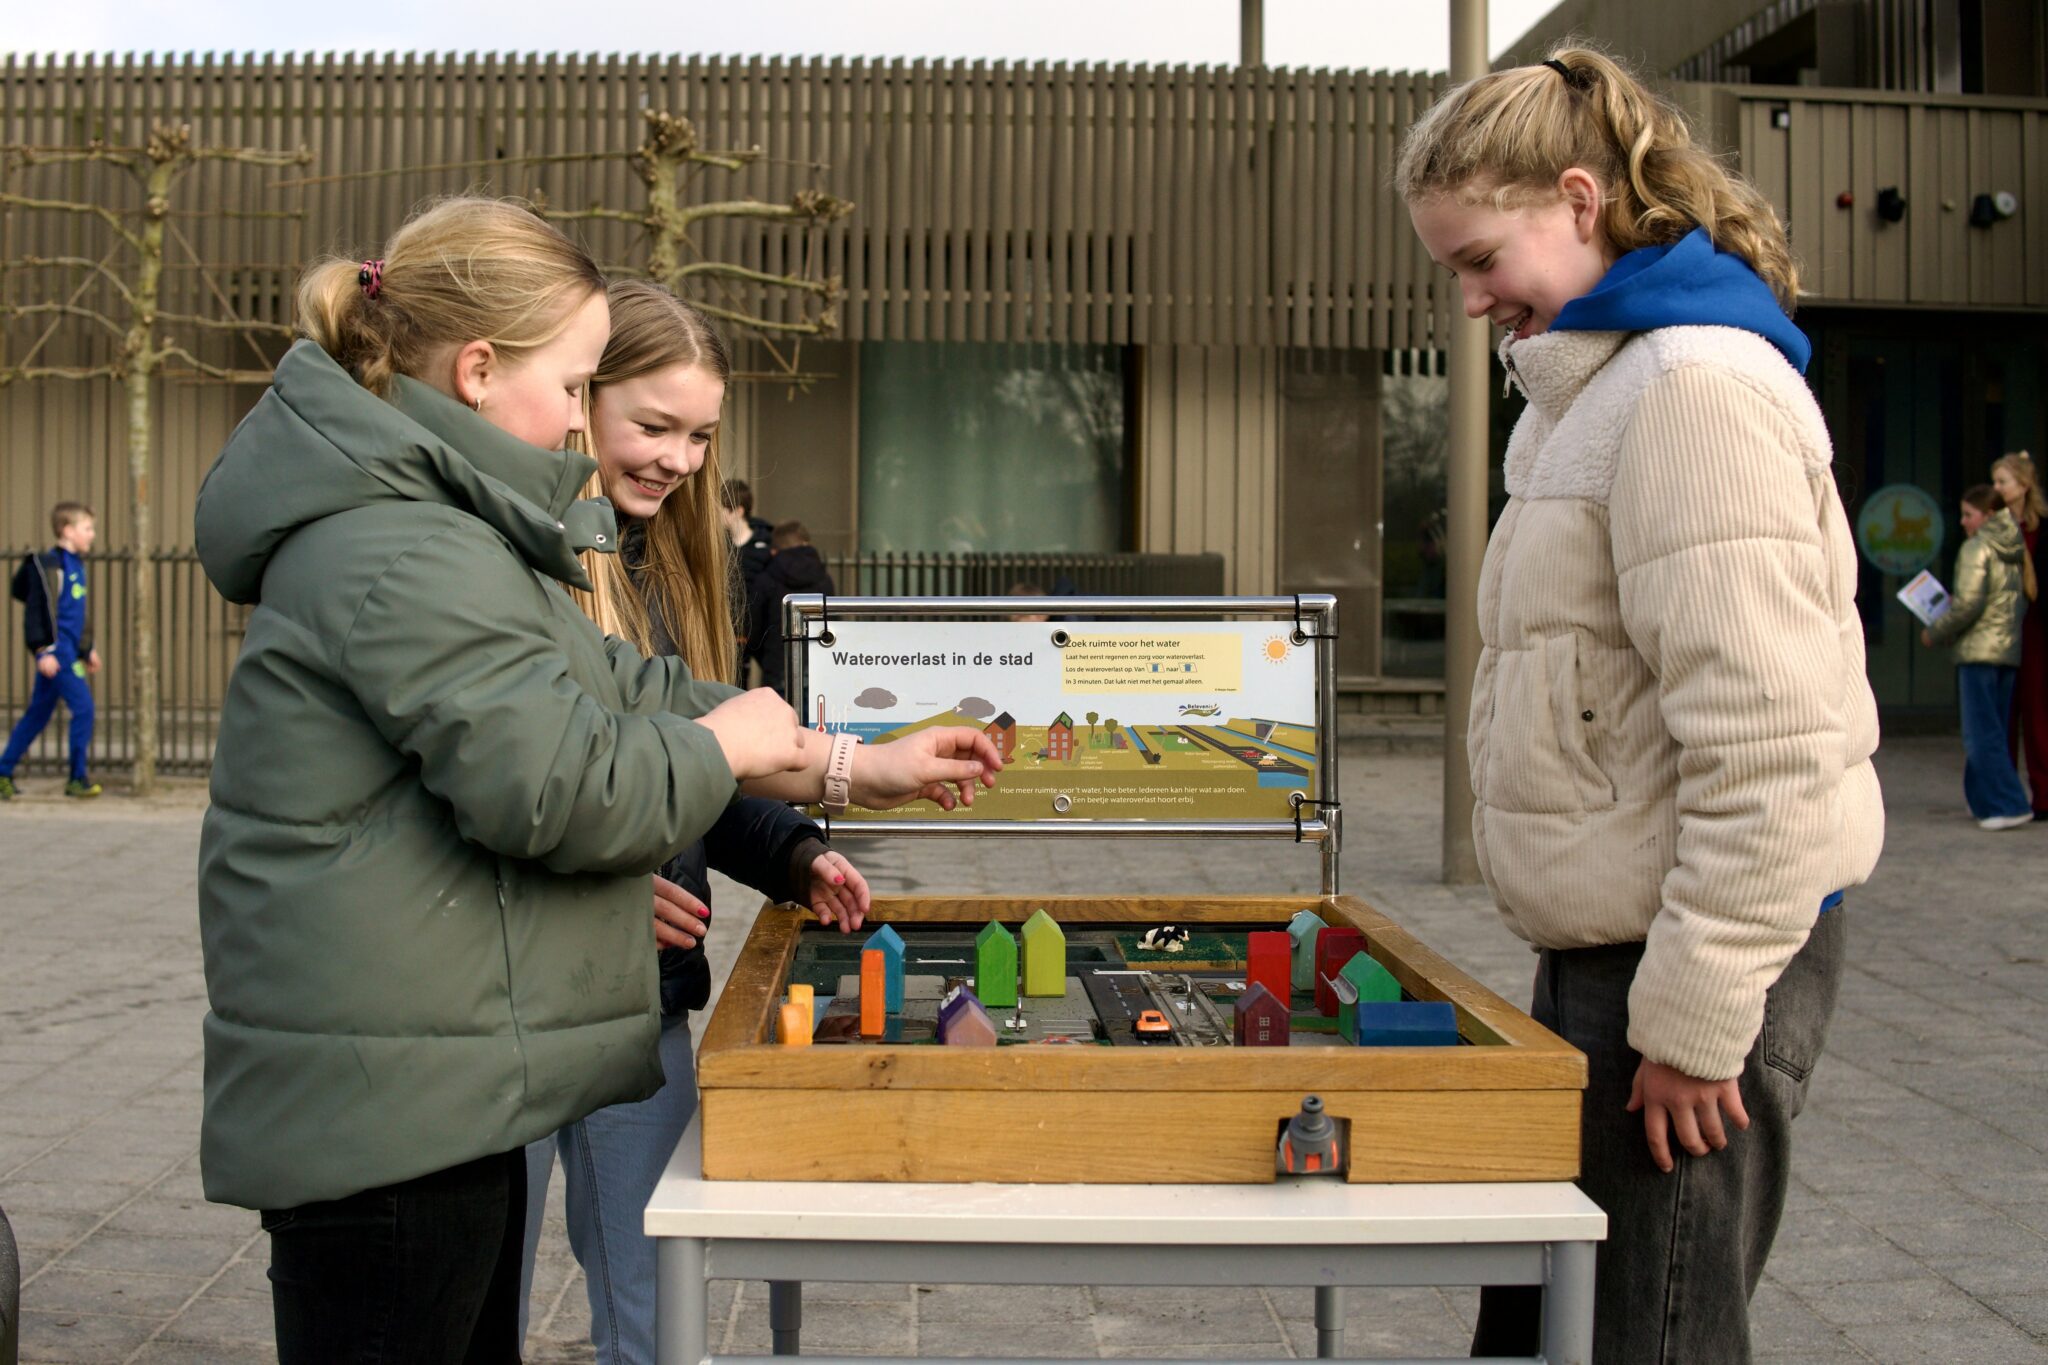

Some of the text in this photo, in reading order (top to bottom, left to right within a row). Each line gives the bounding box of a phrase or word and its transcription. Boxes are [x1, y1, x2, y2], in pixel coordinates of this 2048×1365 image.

[1066, 639, 1087, 648] Zoek
[1089, 639, 1117, 648] ruimte
[1140, 639, 1154, 648] het
[1156, 640, 1181, 648] water
[832, 652, 1034, 666] Wateroverlast in de stad
[1163, 678, 1184, 686] gemaal
[1081, 787, 1101, 795] water,
[1087, 796, 1108, 804] beetje
